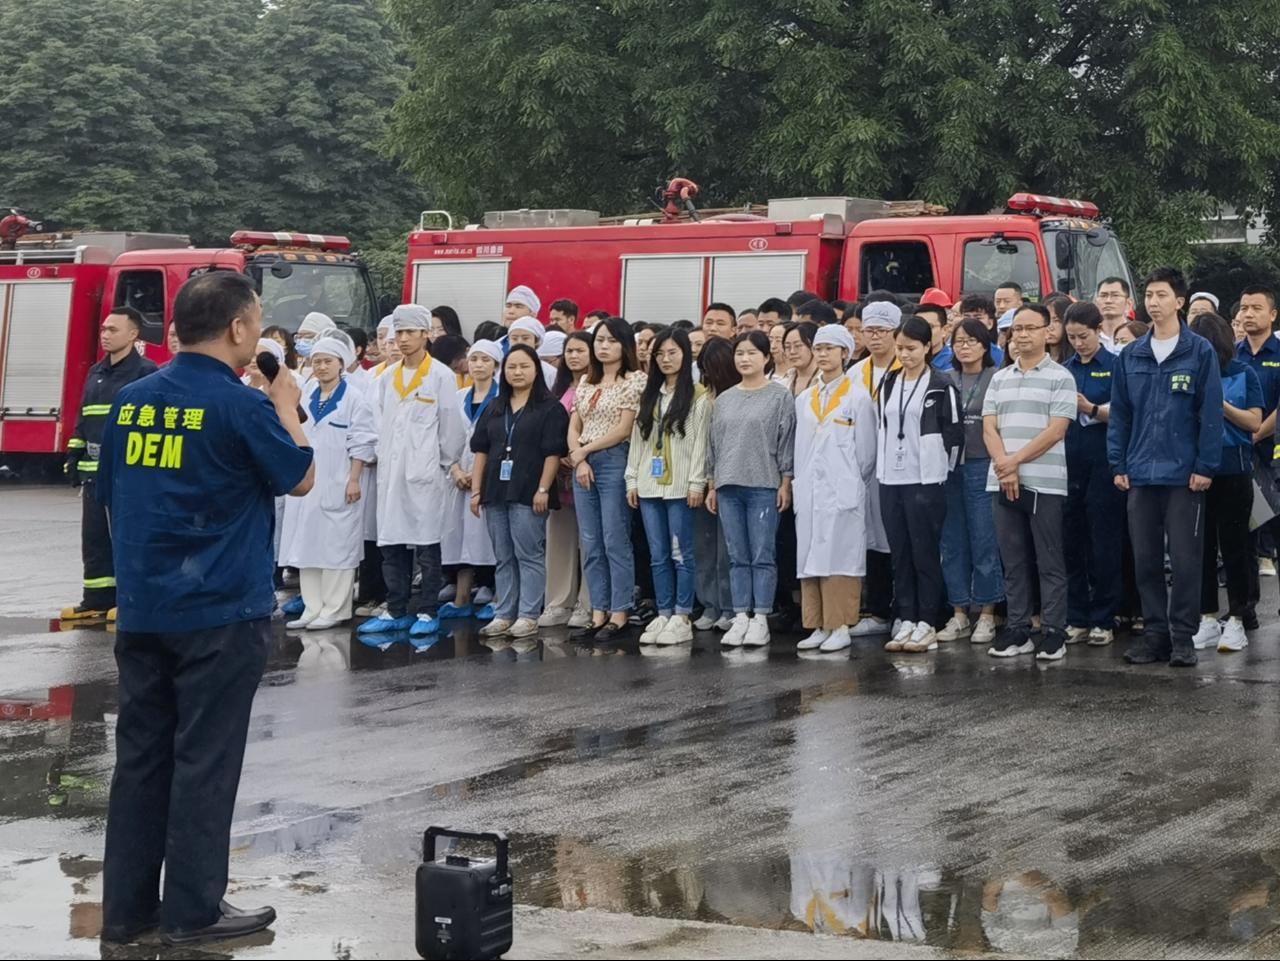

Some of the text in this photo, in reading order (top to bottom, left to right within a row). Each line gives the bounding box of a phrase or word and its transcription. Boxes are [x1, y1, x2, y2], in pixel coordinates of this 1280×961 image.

[117, 403, 205, 430] 应急管理
[126, 431, 183, 469] DEM
